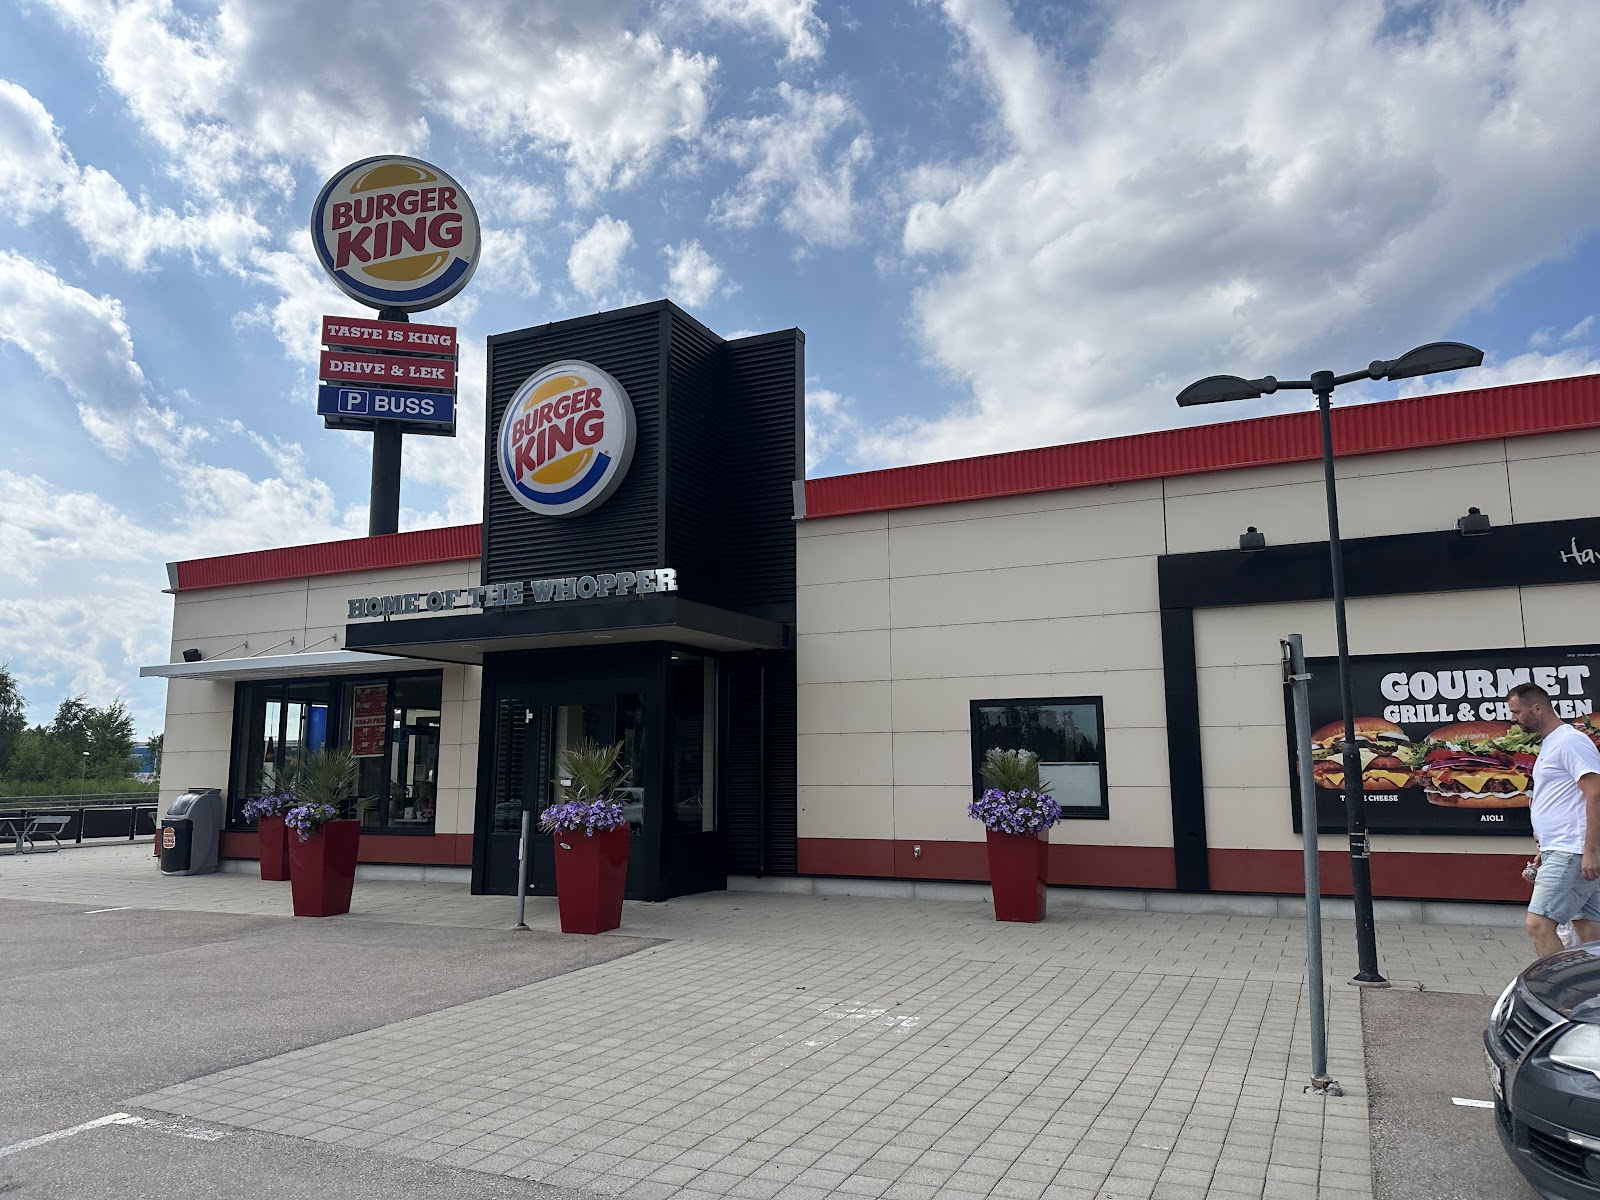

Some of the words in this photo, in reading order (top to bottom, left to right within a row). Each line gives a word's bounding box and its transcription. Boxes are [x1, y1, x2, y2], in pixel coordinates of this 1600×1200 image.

[332, 187, 457, 231] BURGER
[336, 213, 462, 268] KING
[328, 325, 382, 340] TASTE
[387, 330, 403, 341] IS
[408, 332, 451, 346] KING
[329, 360, 385, 375] DRIVE
[390, 365, 404, 376] &
[409, 366, 446, 379] LEK
[347, 392, 361, 410] P
[374, 395, 435, 415] BUSS
[512, 387, 602, 448] BURGER
[515, 410, 605, 483] KING
[347, 592, 419, 619] HOME
[426, 589, 461, 612] OF
[467, 581, 523, 609] THE
[531, 568, 679, 603] WHOPPER
[1381, 665, 1590, 701] GOURMET
[1383, 703, 1454, 724] GRILL
[1456, 702, 1475, 722] &
[1478, 699, 1593, 722] CHEN
[1368, 794, 1399, 802] CHEESE
[1480, 814, 1504, 822] AIOLI
